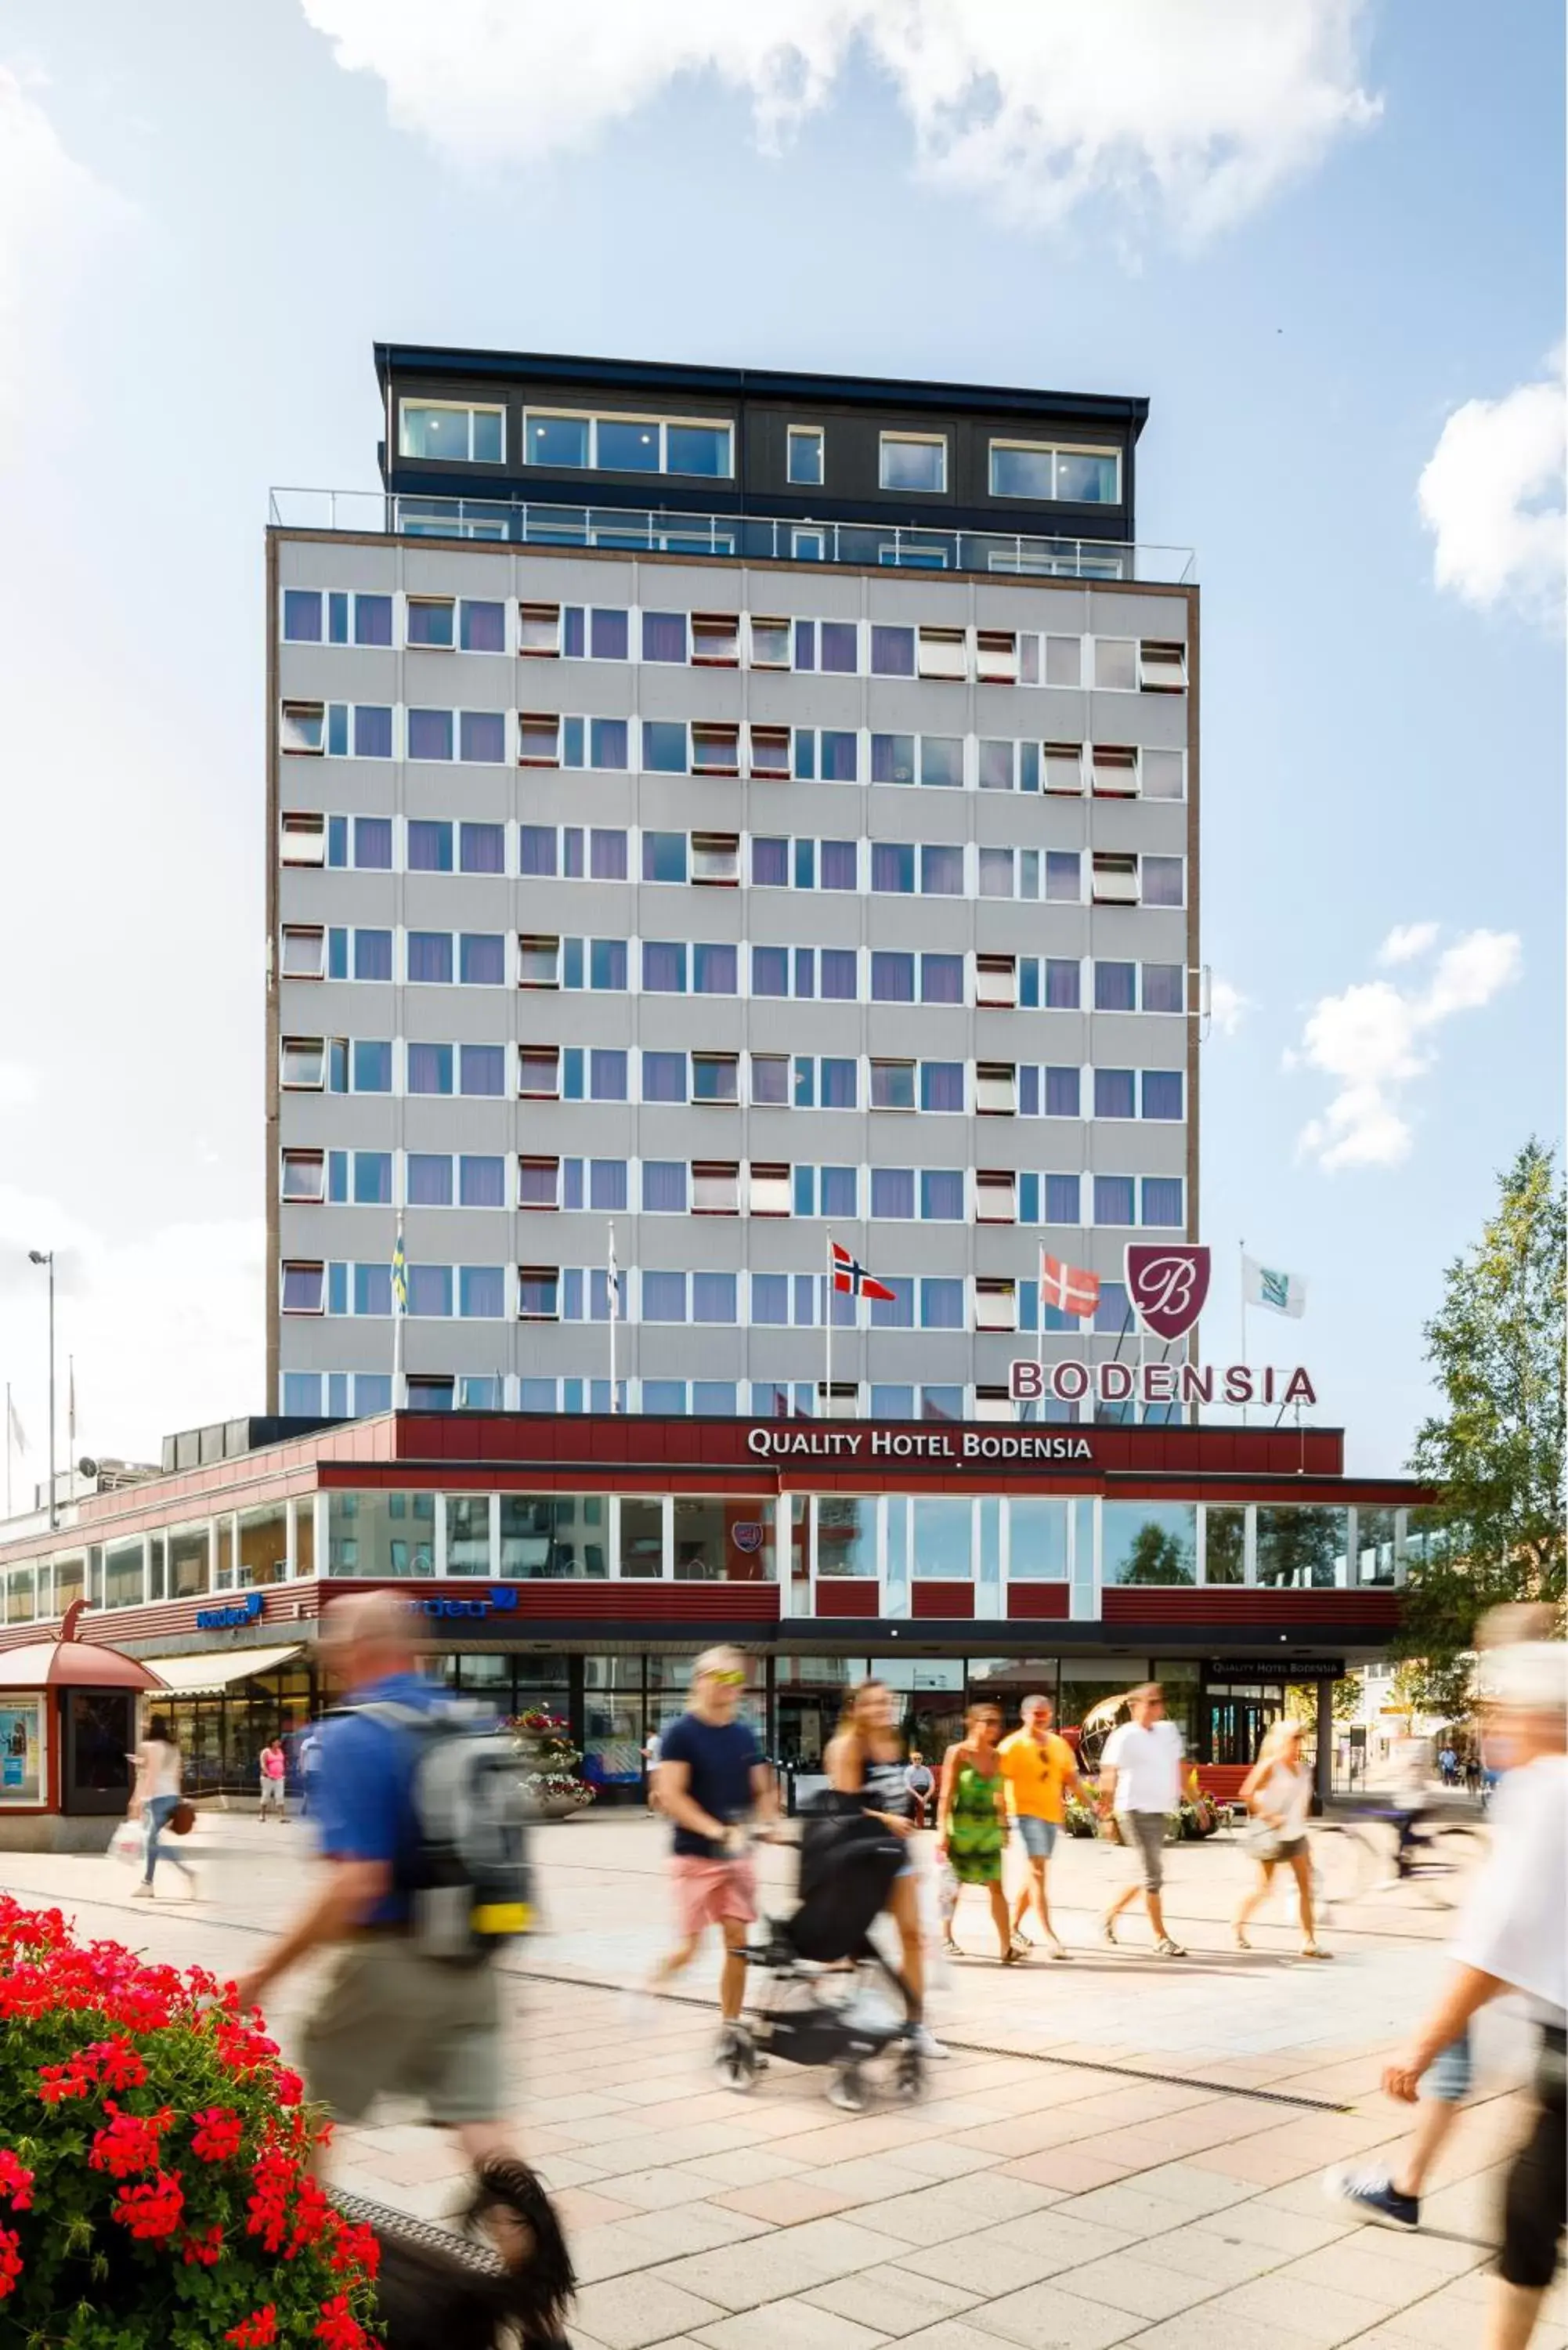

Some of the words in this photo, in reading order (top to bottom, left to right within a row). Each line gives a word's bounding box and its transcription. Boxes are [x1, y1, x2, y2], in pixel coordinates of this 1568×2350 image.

[1136, 1256, 1196, 1315] B
[1009, 1360, 1317, 1406] BODENSIA
[747, 1429, 862, 1456] QUALITY
[872, 1432, 954, 1456] HOTEL
[963, 1433, 1092, 1459] BODENSIA
[196, 1606, 248, 1629] Nordea
[1213, 1662, 1253, 1673] QUALITY
[1257, 1662, 1288, 1672] HOTEL
